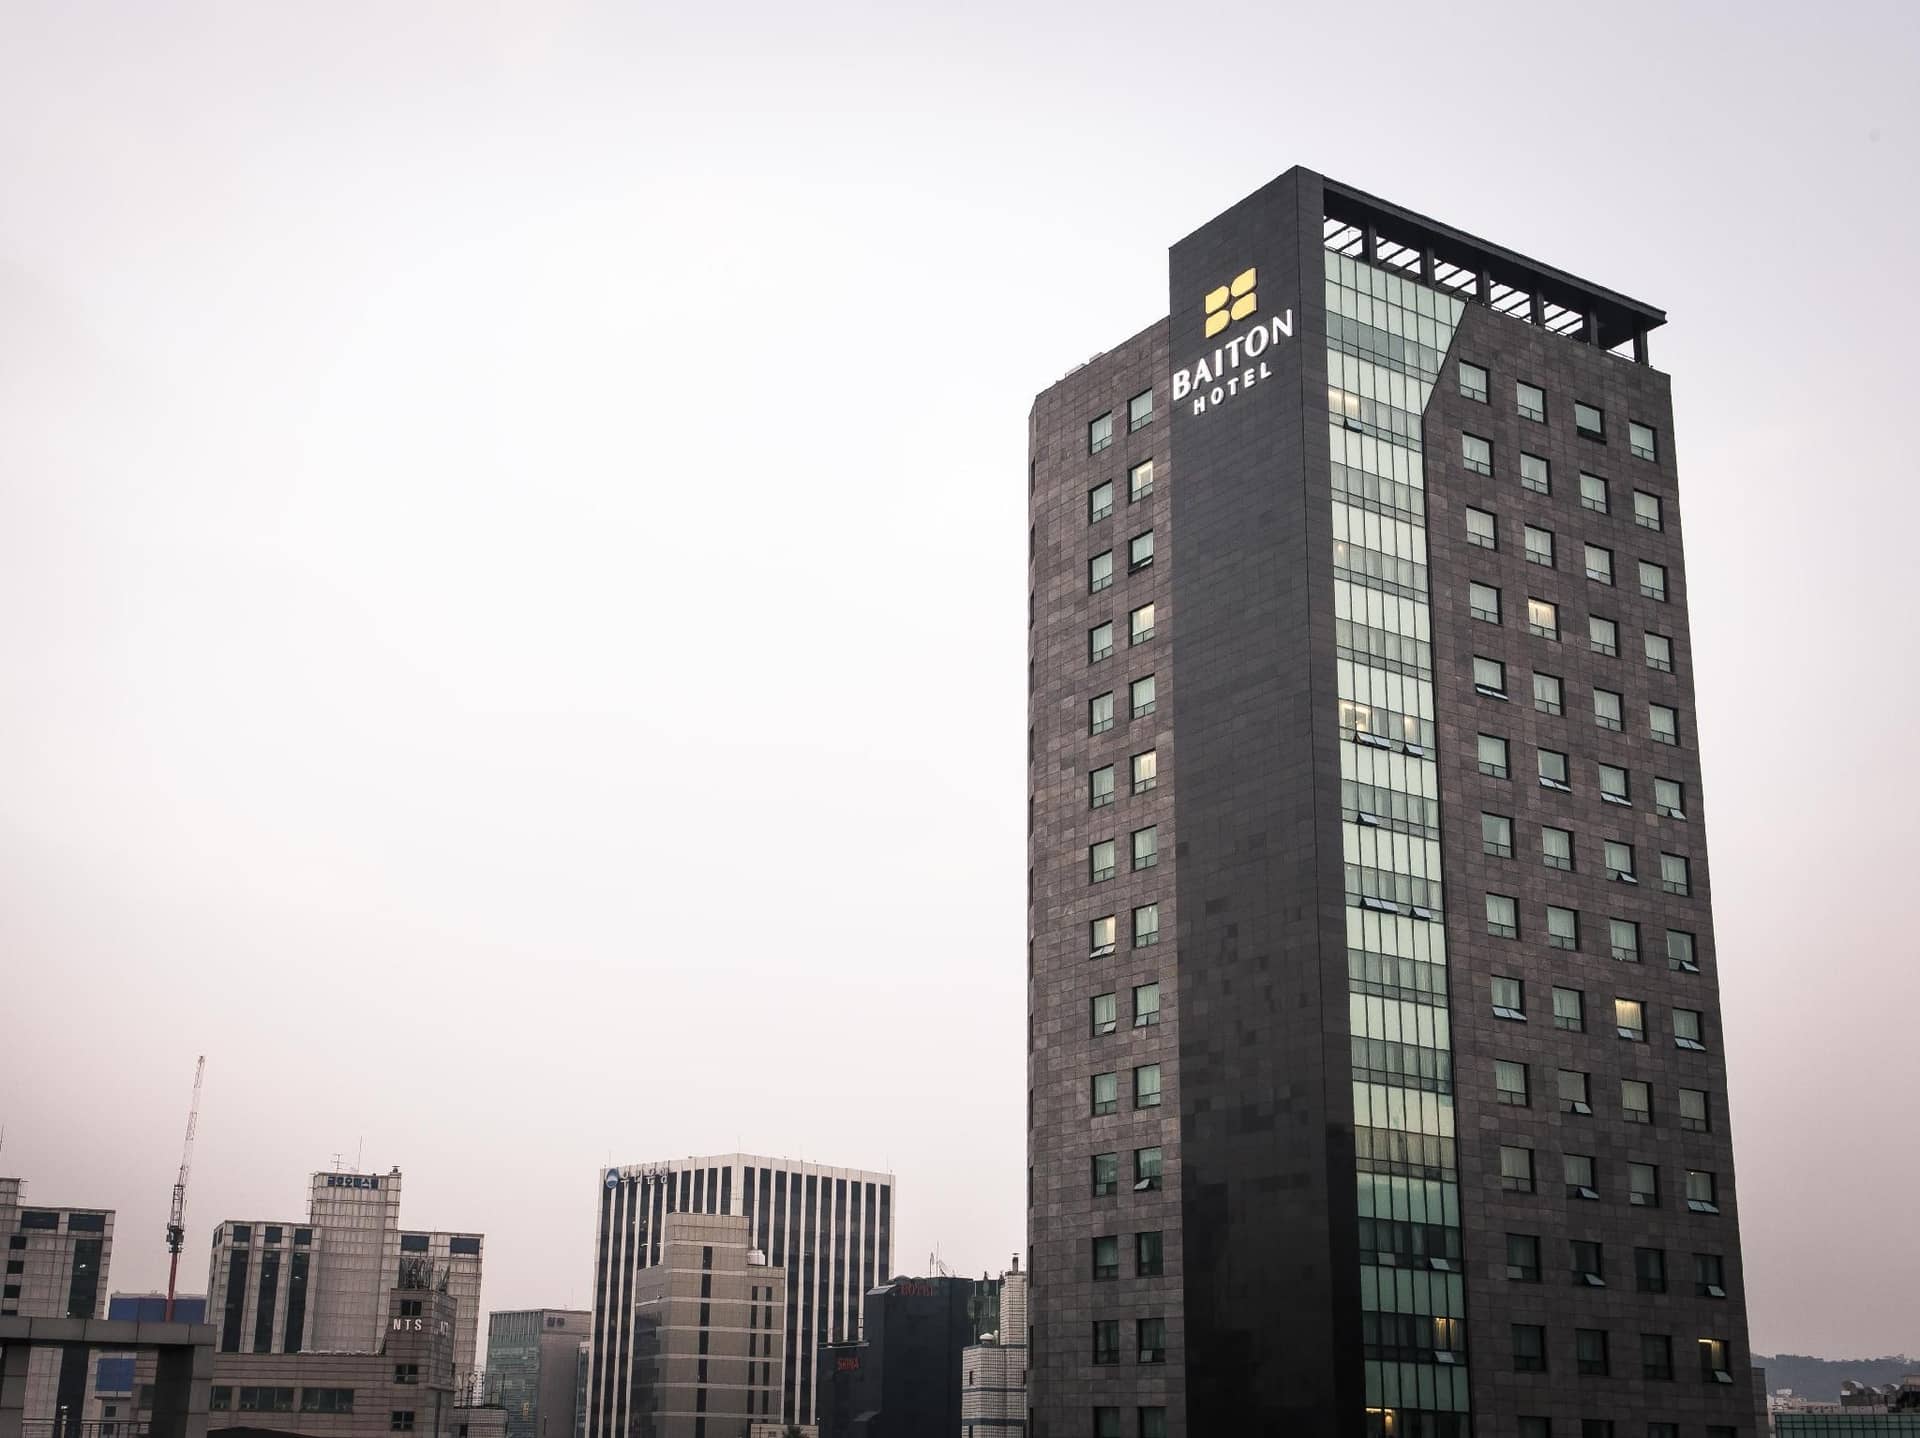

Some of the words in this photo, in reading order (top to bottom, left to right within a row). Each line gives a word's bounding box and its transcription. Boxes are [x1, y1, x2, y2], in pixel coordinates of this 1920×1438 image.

[1173, 308, 1293, 401] BAITON
[1193, 362, 1272, 415] HOTEL
[393, 1318, 422, 1331] NTS
